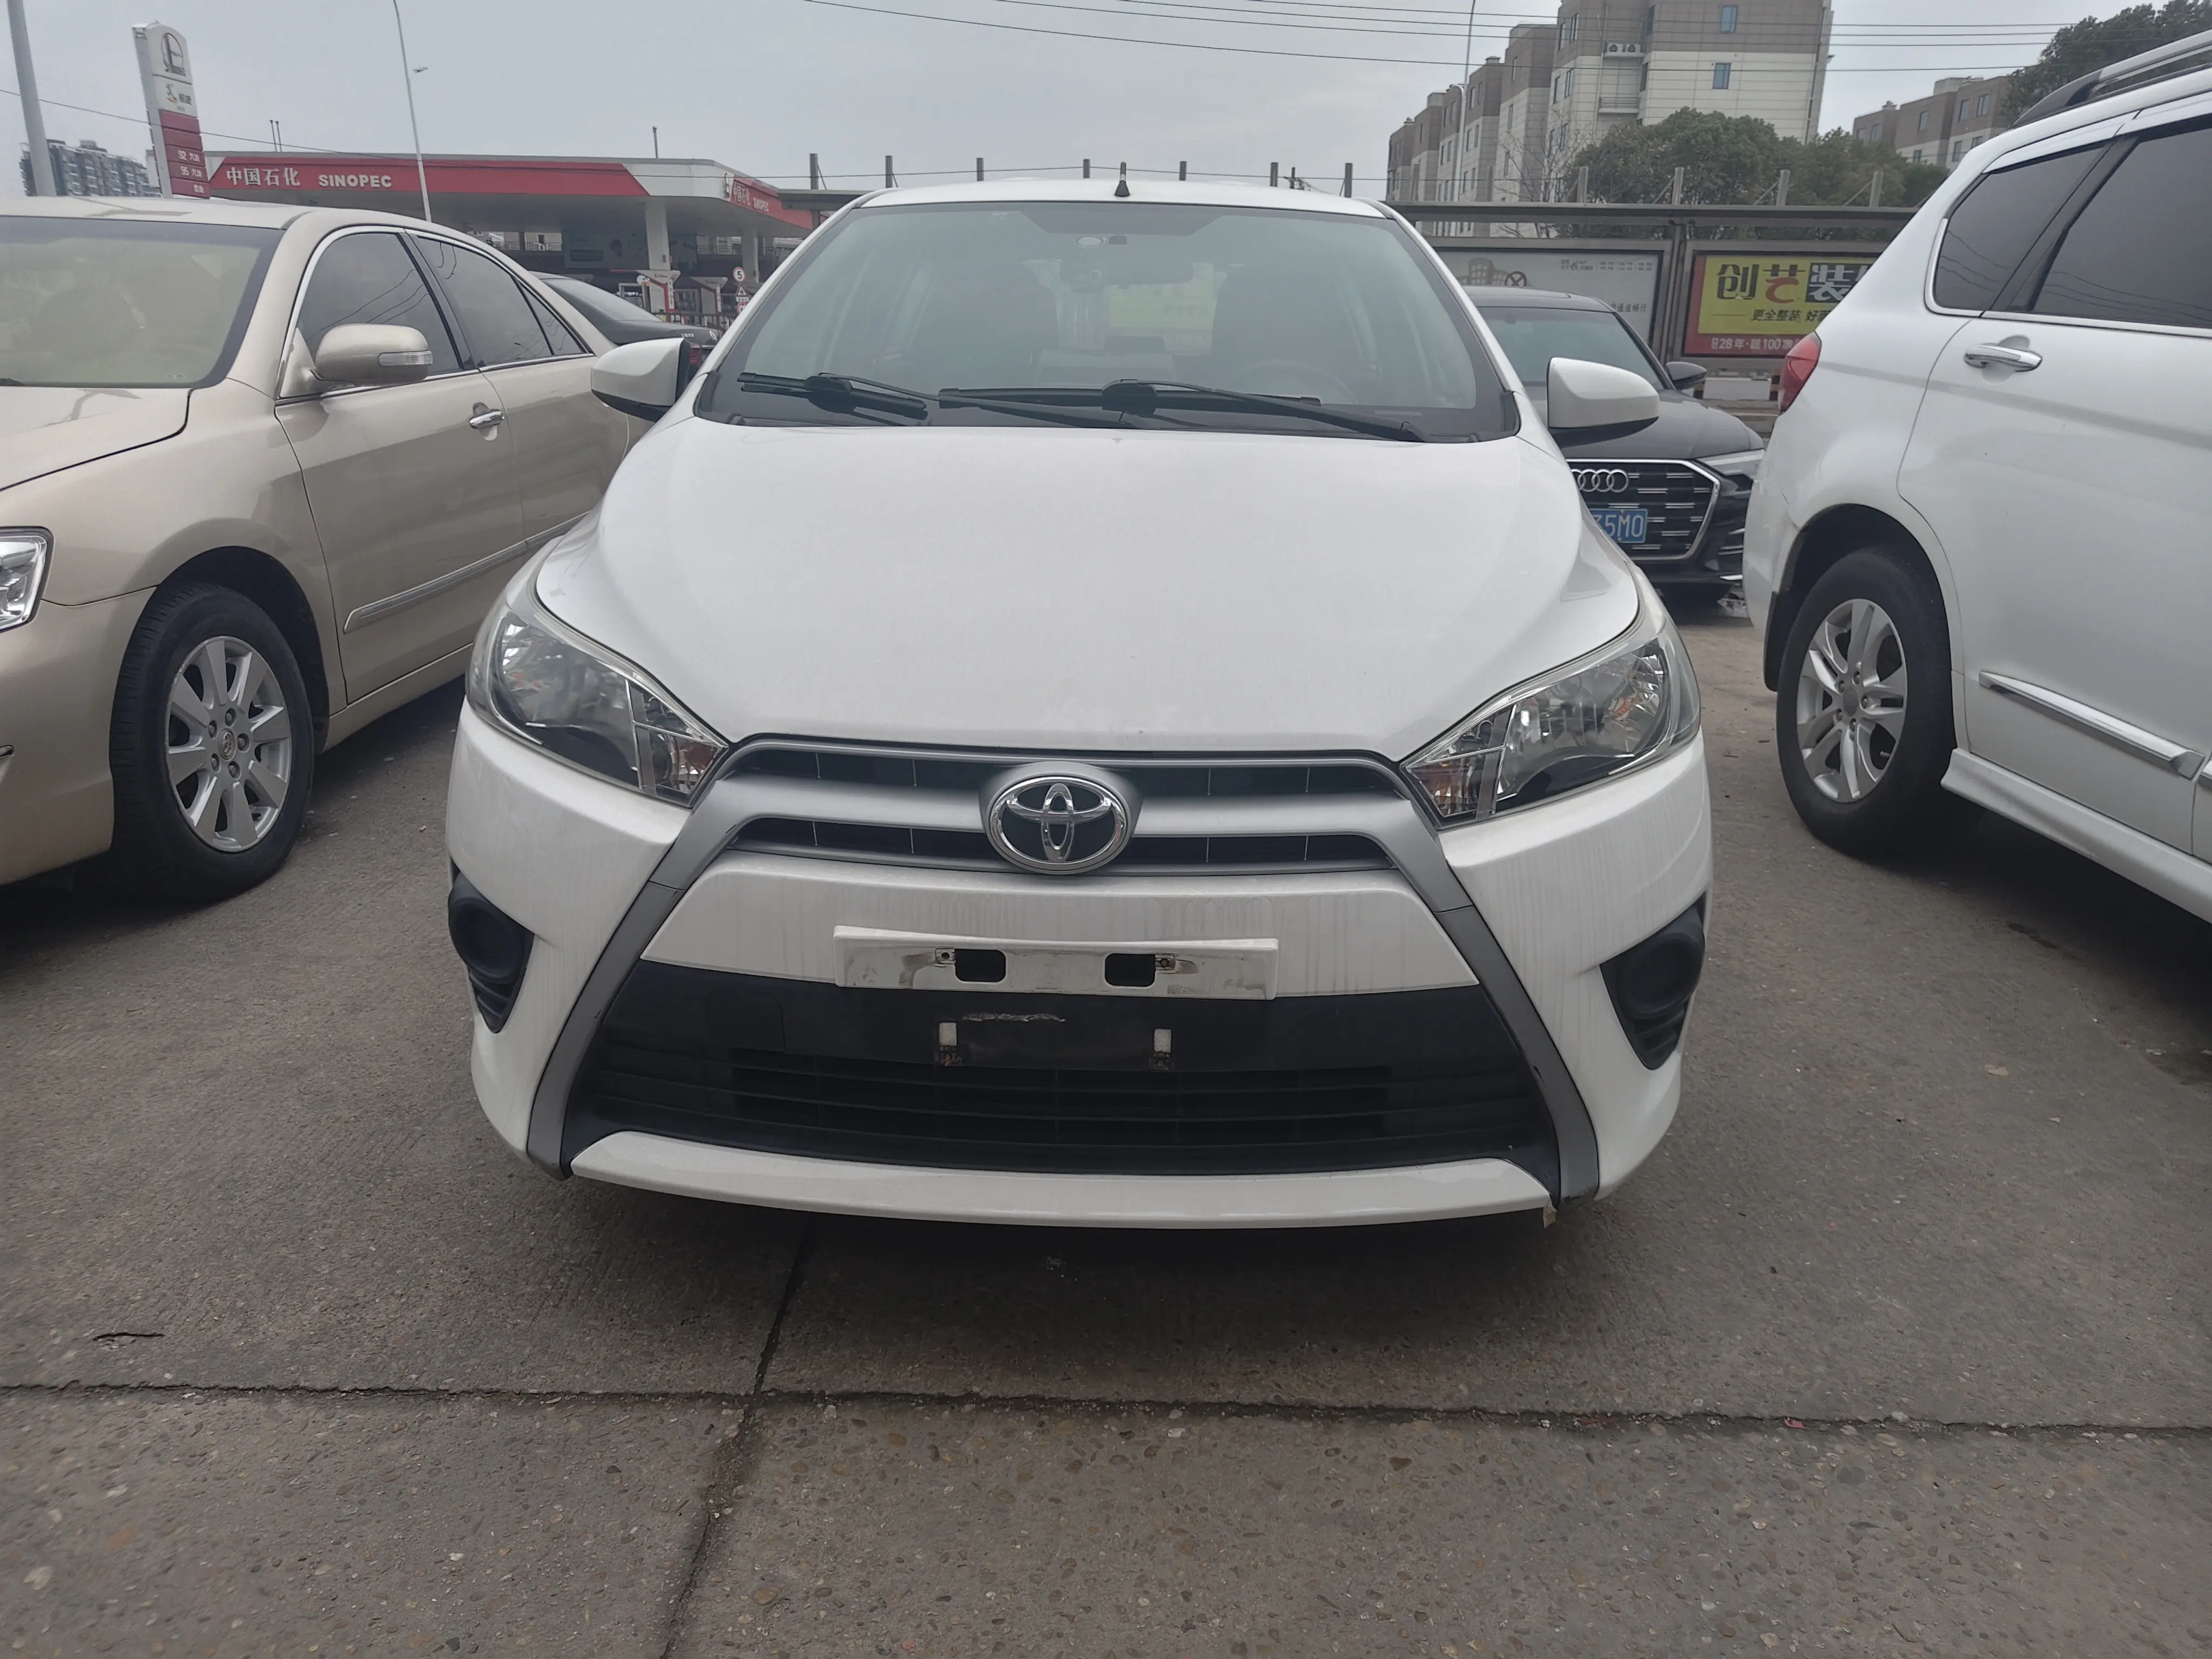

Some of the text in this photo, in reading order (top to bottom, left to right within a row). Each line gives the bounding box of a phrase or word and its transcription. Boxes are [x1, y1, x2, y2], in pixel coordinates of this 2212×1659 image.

[226, 167, 392, 188] 中国石化 SINOPEC
[737, 271, 743, 280] 5
[1716, 262, 1869, 304] 创艺装
